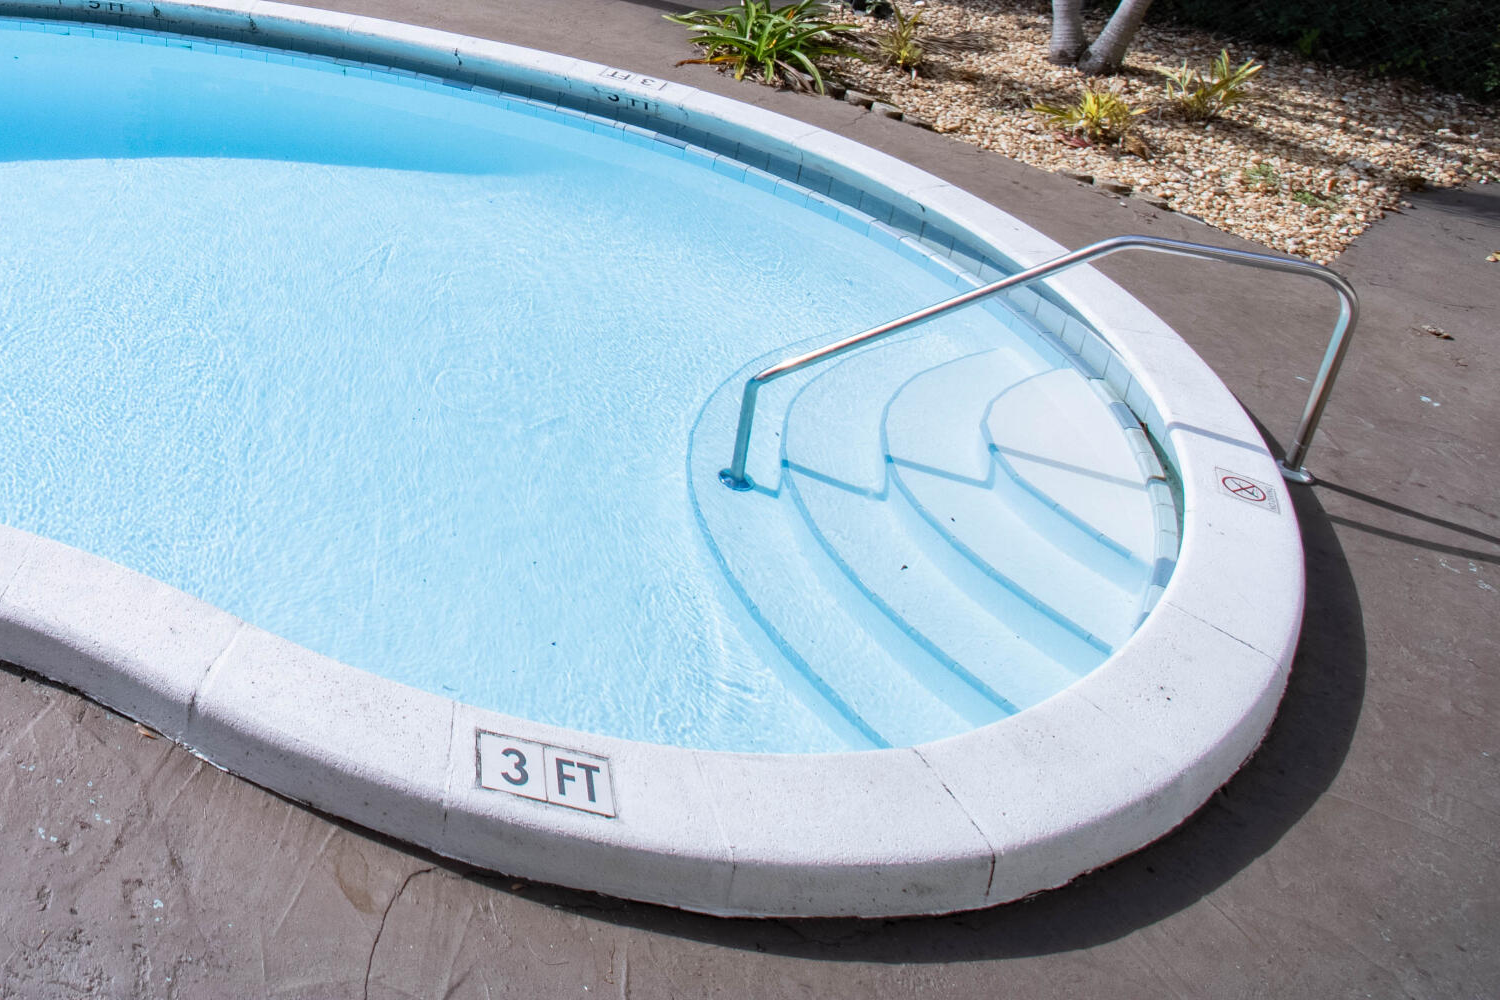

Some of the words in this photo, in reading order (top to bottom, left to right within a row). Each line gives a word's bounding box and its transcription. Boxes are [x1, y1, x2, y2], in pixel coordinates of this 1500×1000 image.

[607, 71, 631, 80] FT
[640, 78, 655, 86] 3
[501, 748, 529, 786] 3
[555, 757, 600, 802] FT
